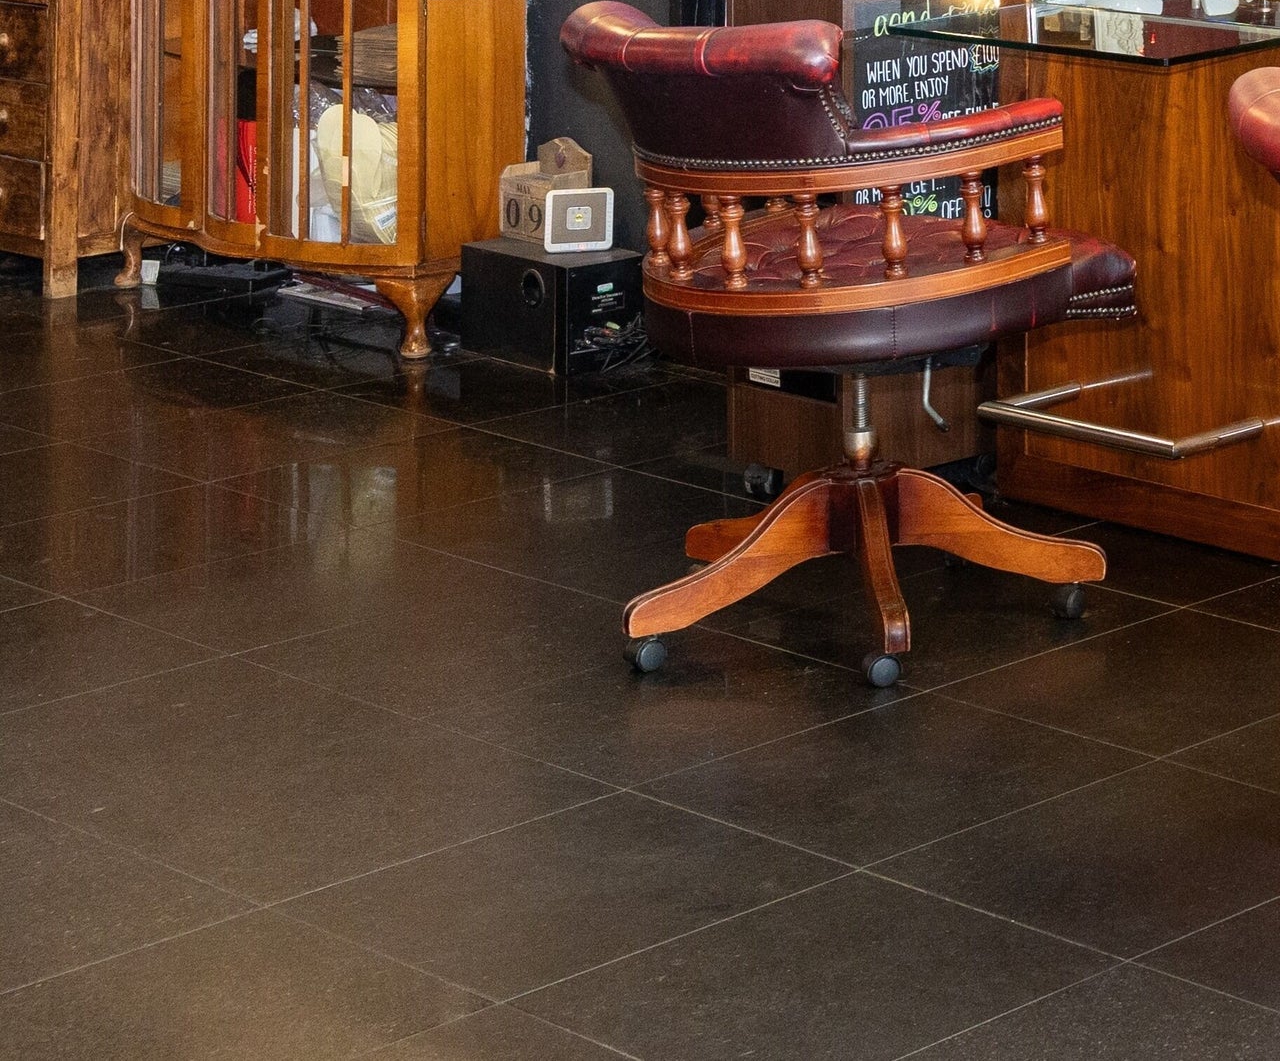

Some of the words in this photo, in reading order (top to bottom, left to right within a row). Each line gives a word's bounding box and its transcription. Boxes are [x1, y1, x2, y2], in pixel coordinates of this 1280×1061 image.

[866, 58, 901, 84] WHEN
[906, 52, 928, 77] YOU
[931, 47, 969, 74] SPEND
[862, 86, 876, 110] OR
[879, 84, 914, 104] MORE,
[915, 75, 949, 100] ENJOY
